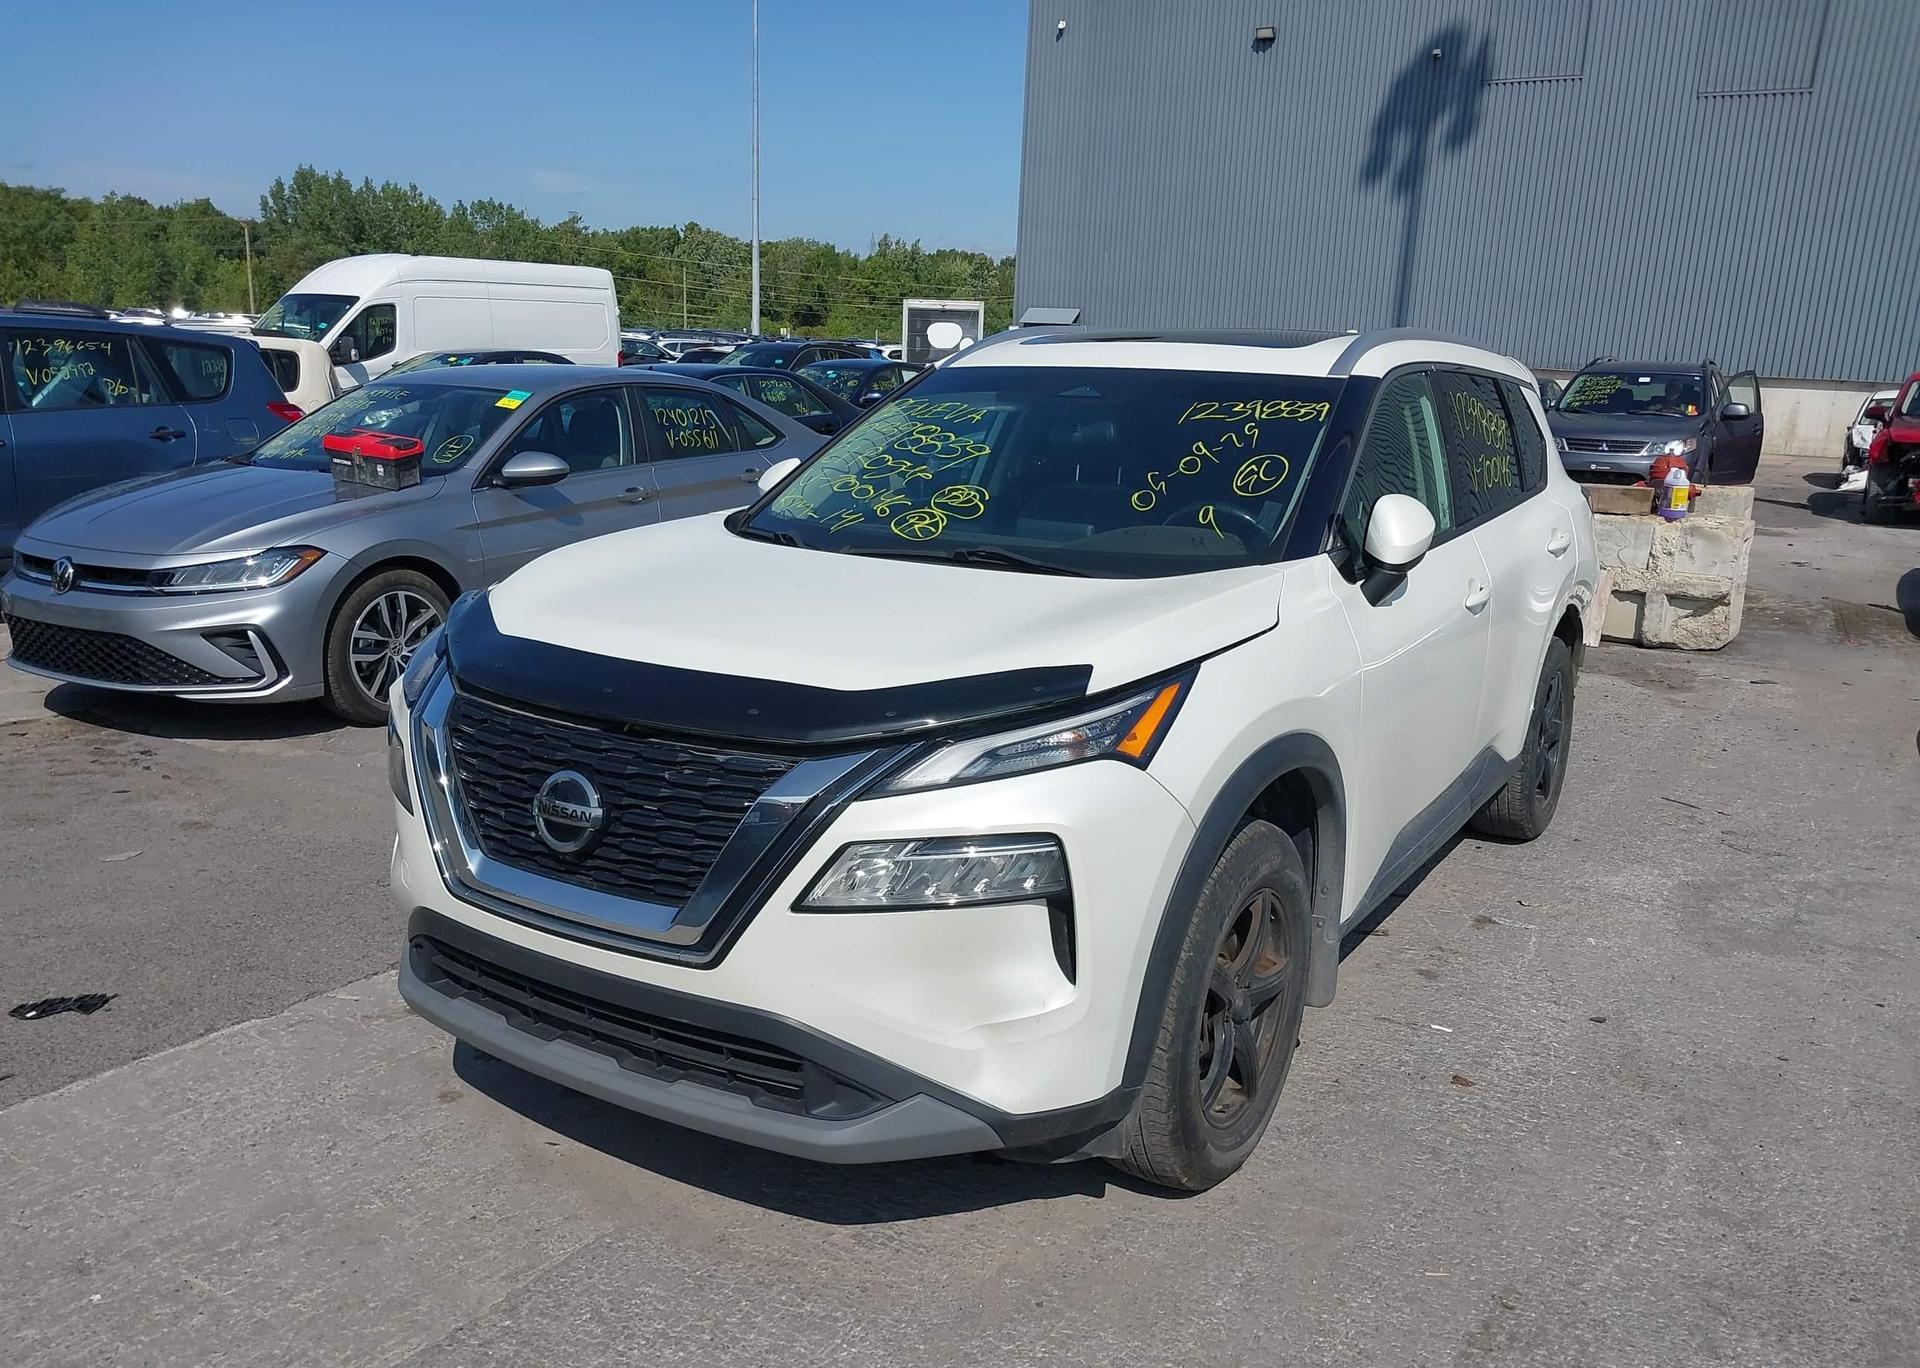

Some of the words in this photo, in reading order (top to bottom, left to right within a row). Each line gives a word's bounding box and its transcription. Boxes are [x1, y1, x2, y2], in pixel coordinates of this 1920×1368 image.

[16, 338, 111, 356] 12396654
[1177, 399, 1330, 425] 12398839
[665, 428, 719, 450] V-055611
[540, 799, 593, 824] NISSAN
